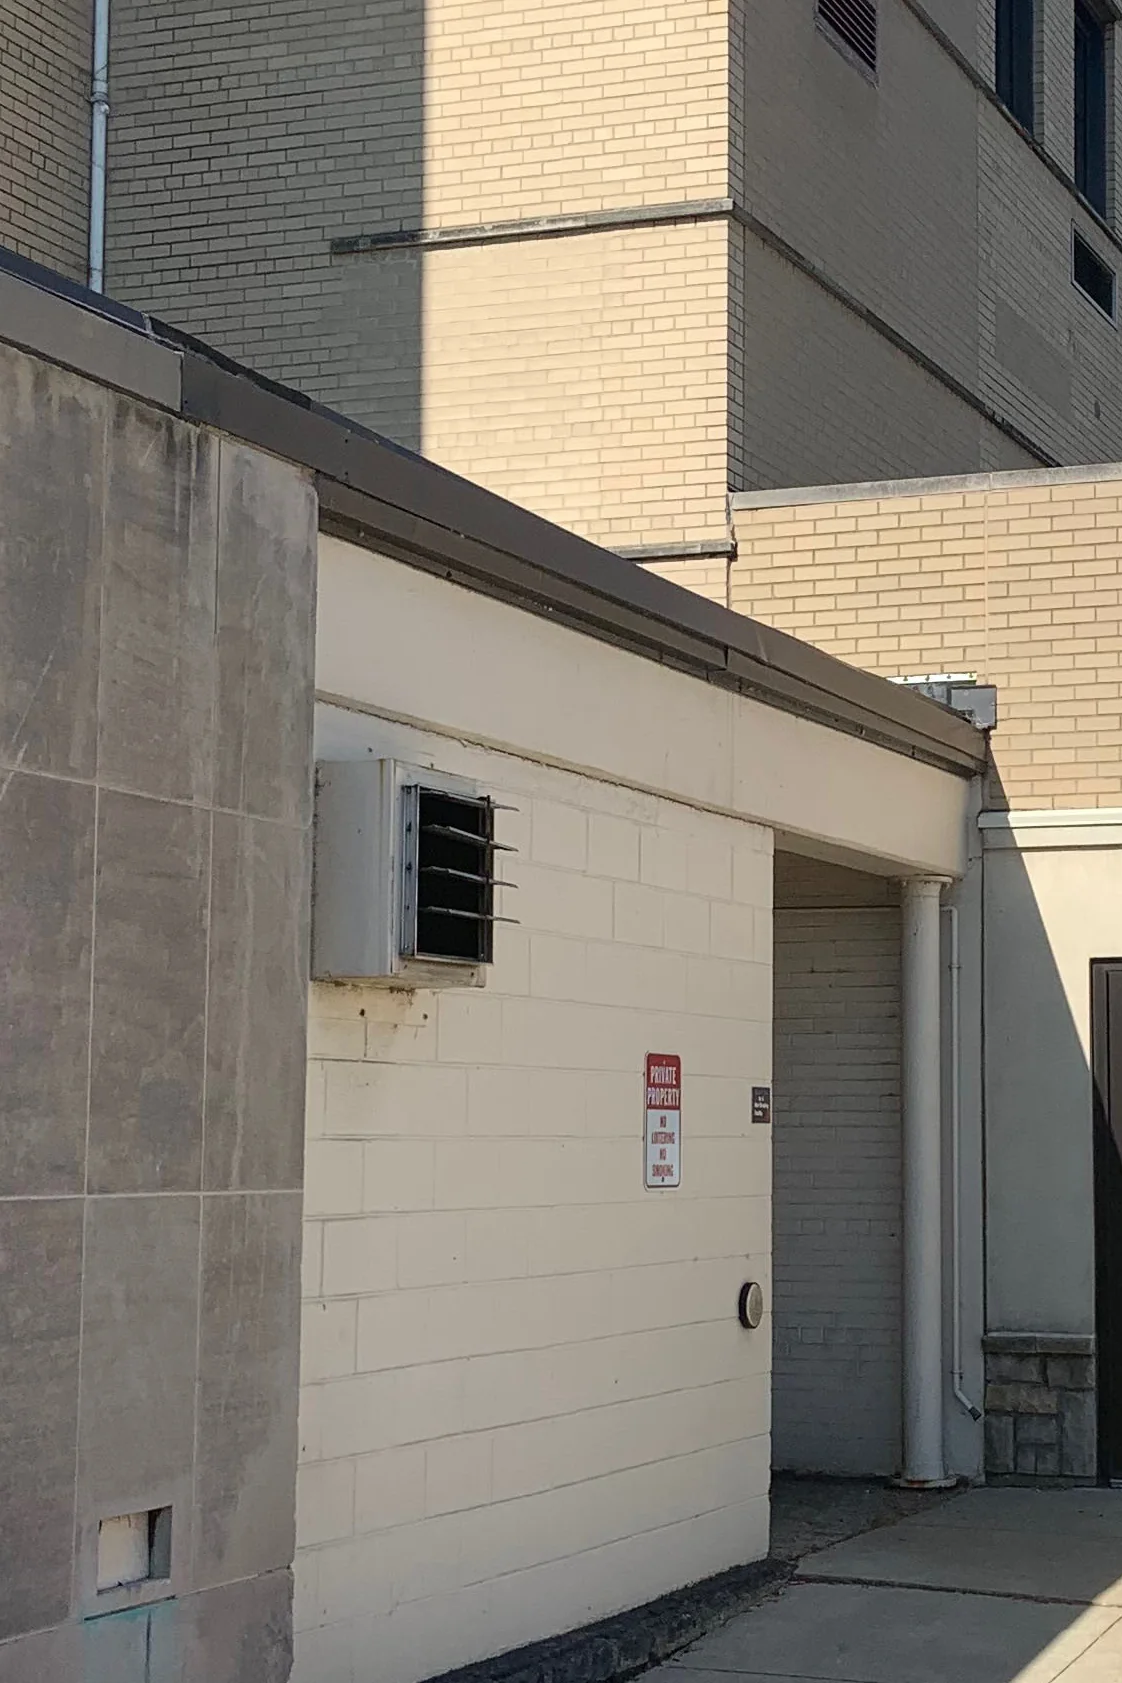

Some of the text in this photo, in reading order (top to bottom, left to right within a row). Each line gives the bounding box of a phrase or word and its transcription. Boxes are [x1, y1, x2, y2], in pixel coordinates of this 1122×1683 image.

[650, 1065, 677, 1085] PRIVATE
[647, 1087, 680, 1107] PROPERTY
[659, 1115, 667, 1128] NO
[651, 1131, 675, 1145] LOITERING
[659, 1148, 667, 1160] NO
[652, 1164, 674, 1177] SMOKING
